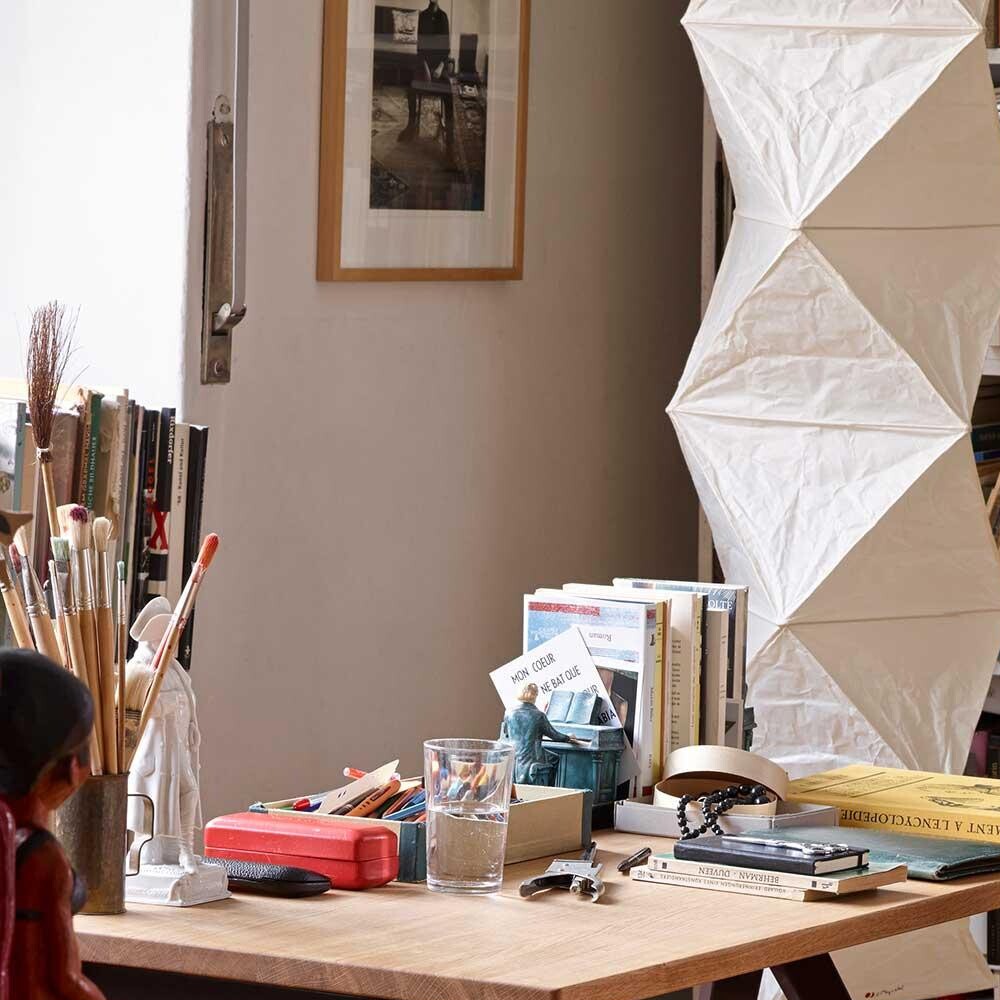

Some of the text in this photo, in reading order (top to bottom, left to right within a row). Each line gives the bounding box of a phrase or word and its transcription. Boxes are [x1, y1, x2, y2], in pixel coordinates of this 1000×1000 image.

[589, 632, 612, 642] Roman
[510, 653, 556, 684] MON COEUR
[540, 664, 582, 695] NE BAT QUE
[840, 809, 949, 832] L'ENCYCLOPEDIE
[955, 821, 963, 831] A
[698, 866, 780, 884] BEHRMAN DUVEEN
